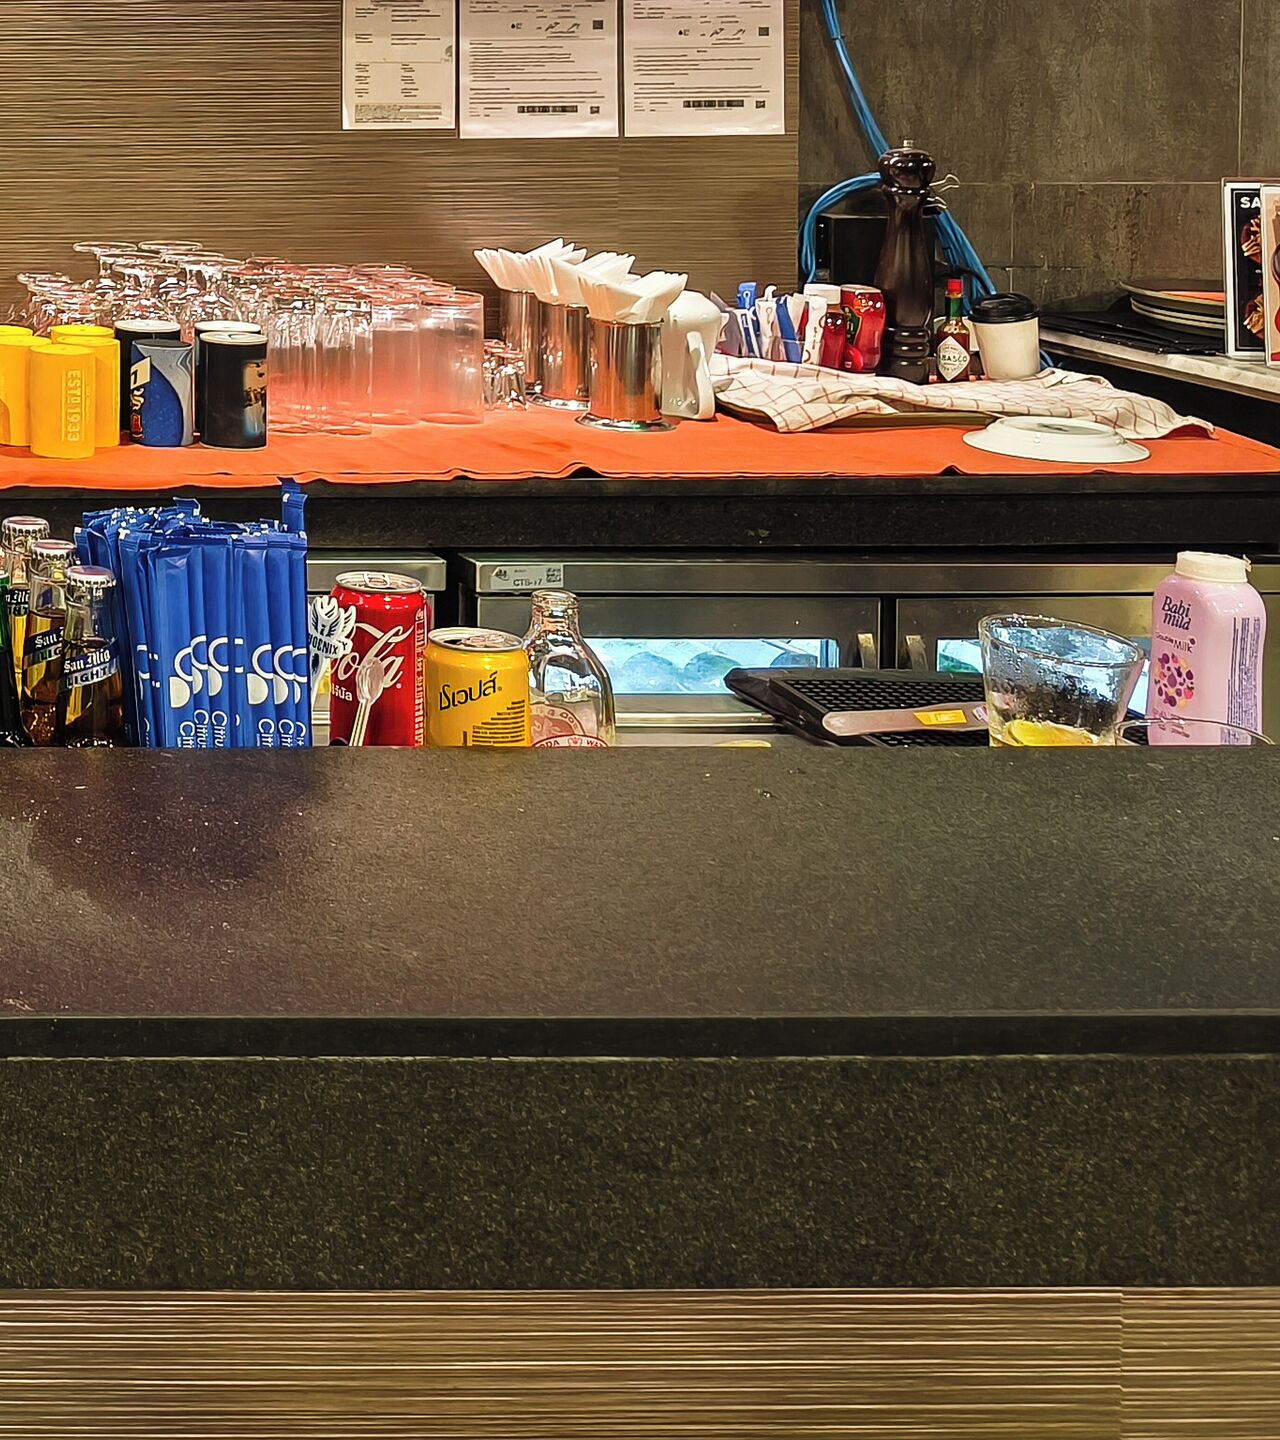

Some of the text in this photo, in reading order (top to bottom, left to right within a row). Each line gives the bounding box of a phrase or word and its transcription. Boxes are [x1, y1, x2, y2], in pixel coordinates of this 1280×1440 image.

[1162, 596, 1191, 618] Babi
[1163, 613, 1192, 631] mild
[35, 634, 57, 649] San
[1174, 640, 1193, 653] Milk
[63, 649, 111, 673] San Mig
[66, 664, 108, 688] LIGHT
